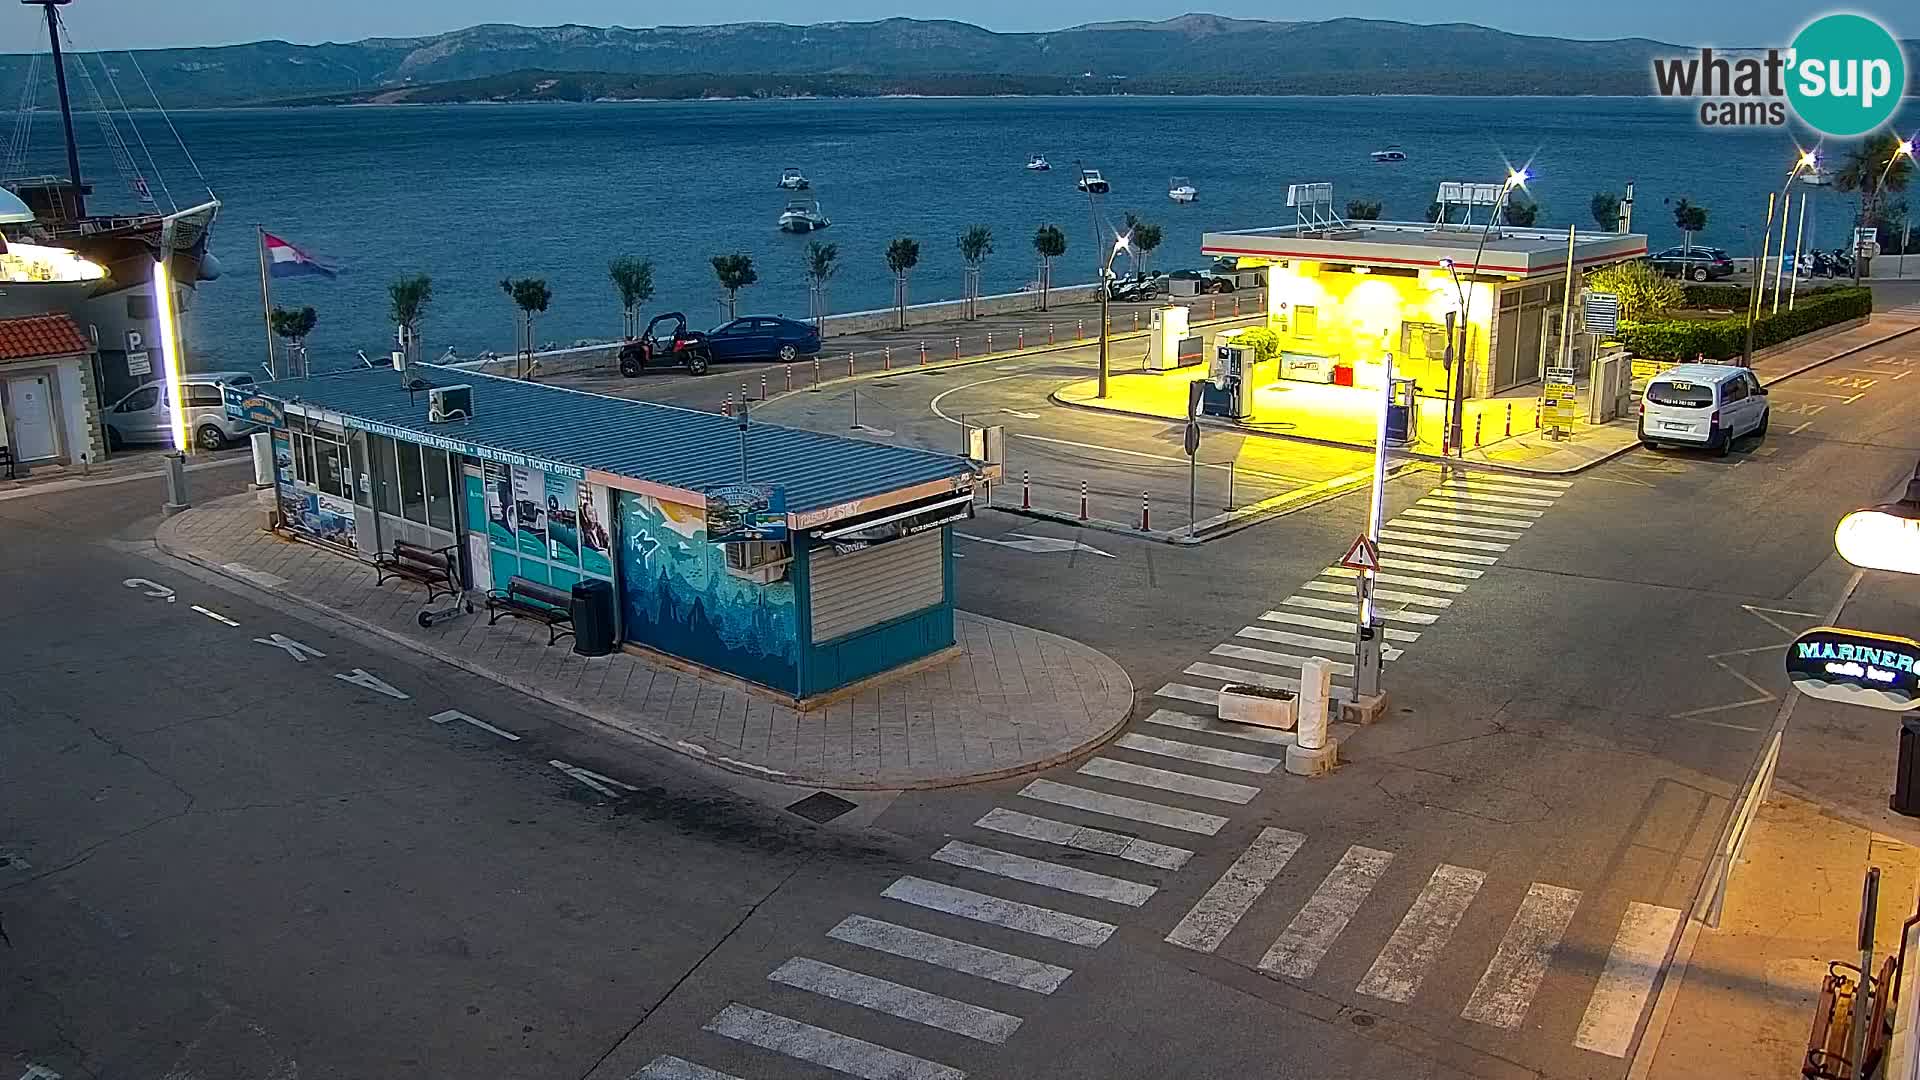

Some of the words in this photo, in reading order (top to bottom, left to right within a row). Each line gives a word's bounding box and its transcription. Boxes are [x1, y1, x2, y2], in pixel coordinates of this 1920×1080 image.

[129, 332, 142, 350] P
[1672, 383, 1691, 391] TAXI
[394, 428, 435, 446] AUTOBUSNA
[435, 438, 467, 453] POSTAJA
[477, 446, 492, 459] BUS
[493, 450, 525, 466] STATION
[527, 458, 553, 473] TICKET
[554, 464, 582, 478] OFFICE
